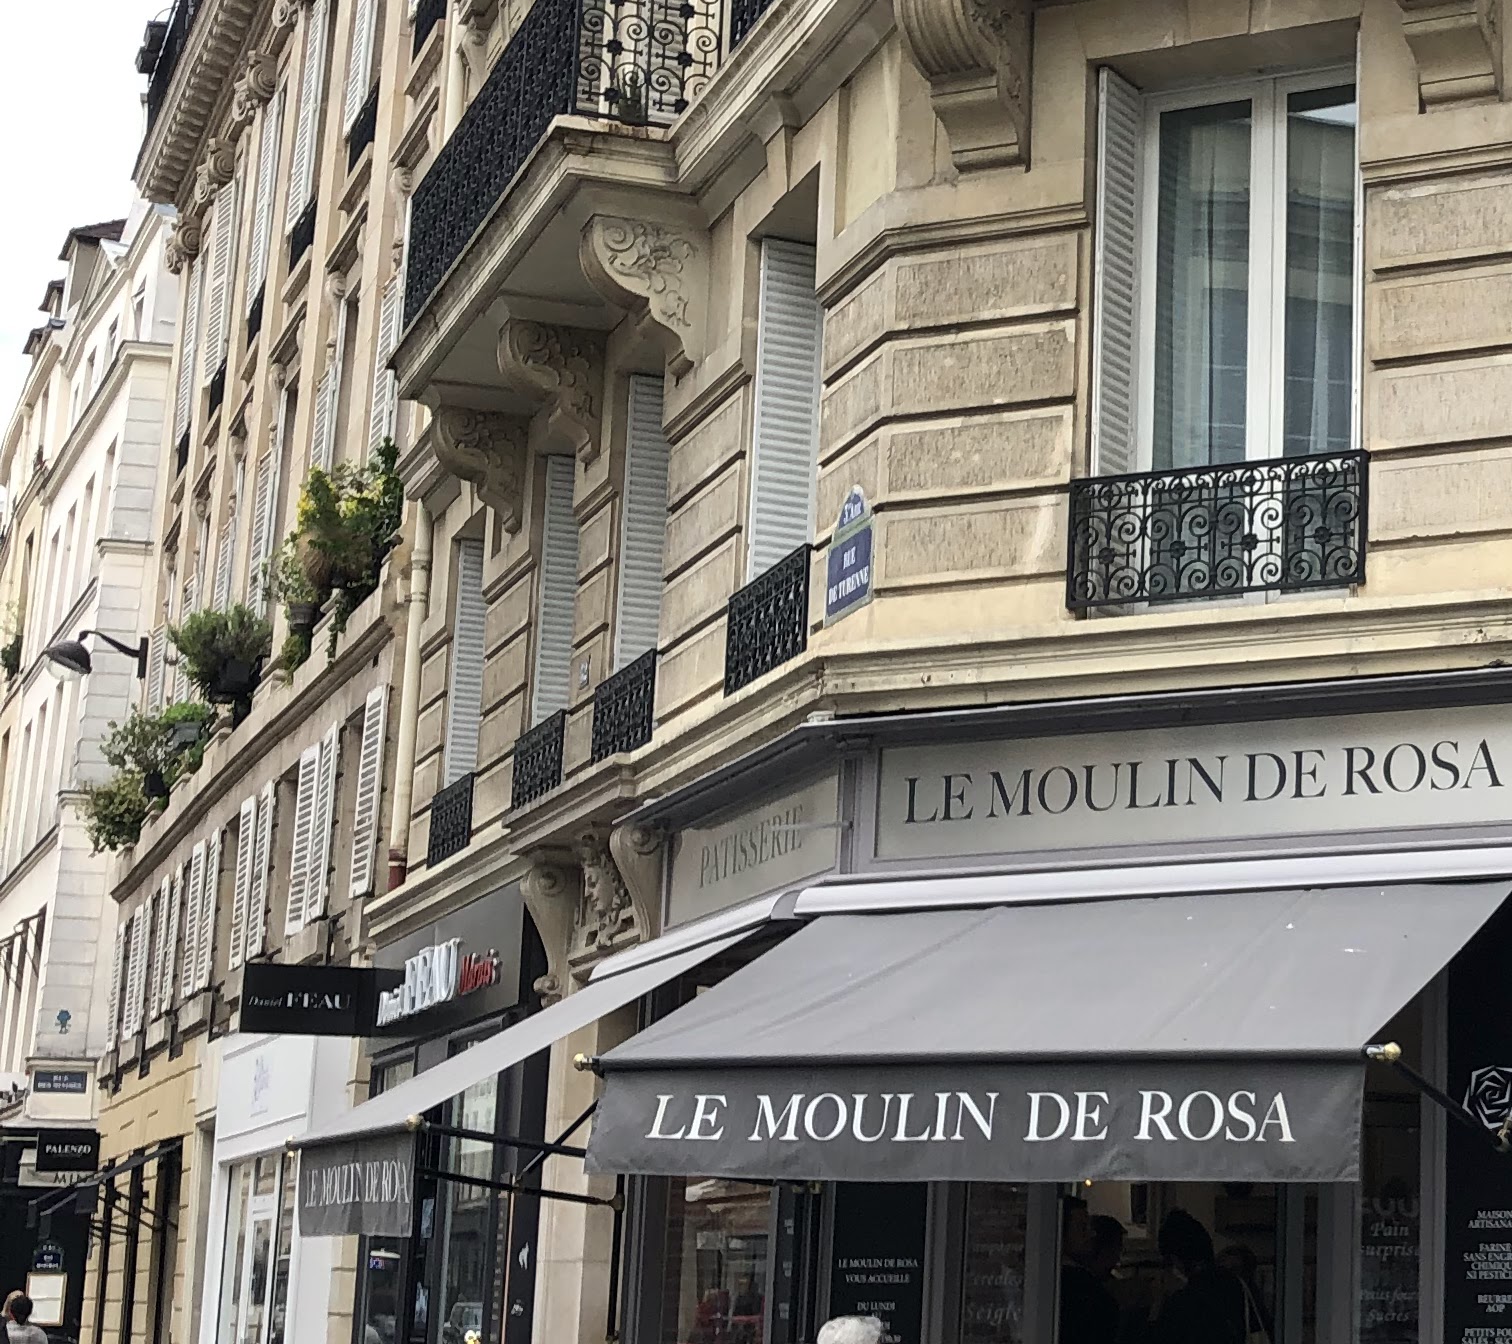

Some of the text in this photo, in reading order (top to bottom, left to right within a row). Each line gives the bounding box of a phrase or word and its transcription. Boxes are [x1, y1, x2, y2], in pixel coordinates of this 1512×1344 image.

[843, 546, 856, 570] RUE
[828, 565, 869, 605] DE TURENNE
[905, 739, 1505, 824] LE MOULIN DE ROSA
[700, 804, 804, 889] PATISSERIE
[645, 1090, 1297, 1144] LE MOULIN DE ROSA
[364, 1161, 380, 1204] DE
[1479, 1243, 1512, 1252] FARINE
[1463, 1252, 1487, 1262] SANS
[849, 1258, 883, 1268] MOULIN
[884, 1258, 896, 1268] DE
[896, 1258, 918, 1268] ROSA
[845, 1273, 911, 1284] VOUS ACCUEILLE
[1466, 1270, 1477, 1280] NI
[857, 1301, 896, 1311] DU LUNDI
[1485, 1303, 1506, 1313] AOP
[1464, 1327, 1496, 1337] PETITS
